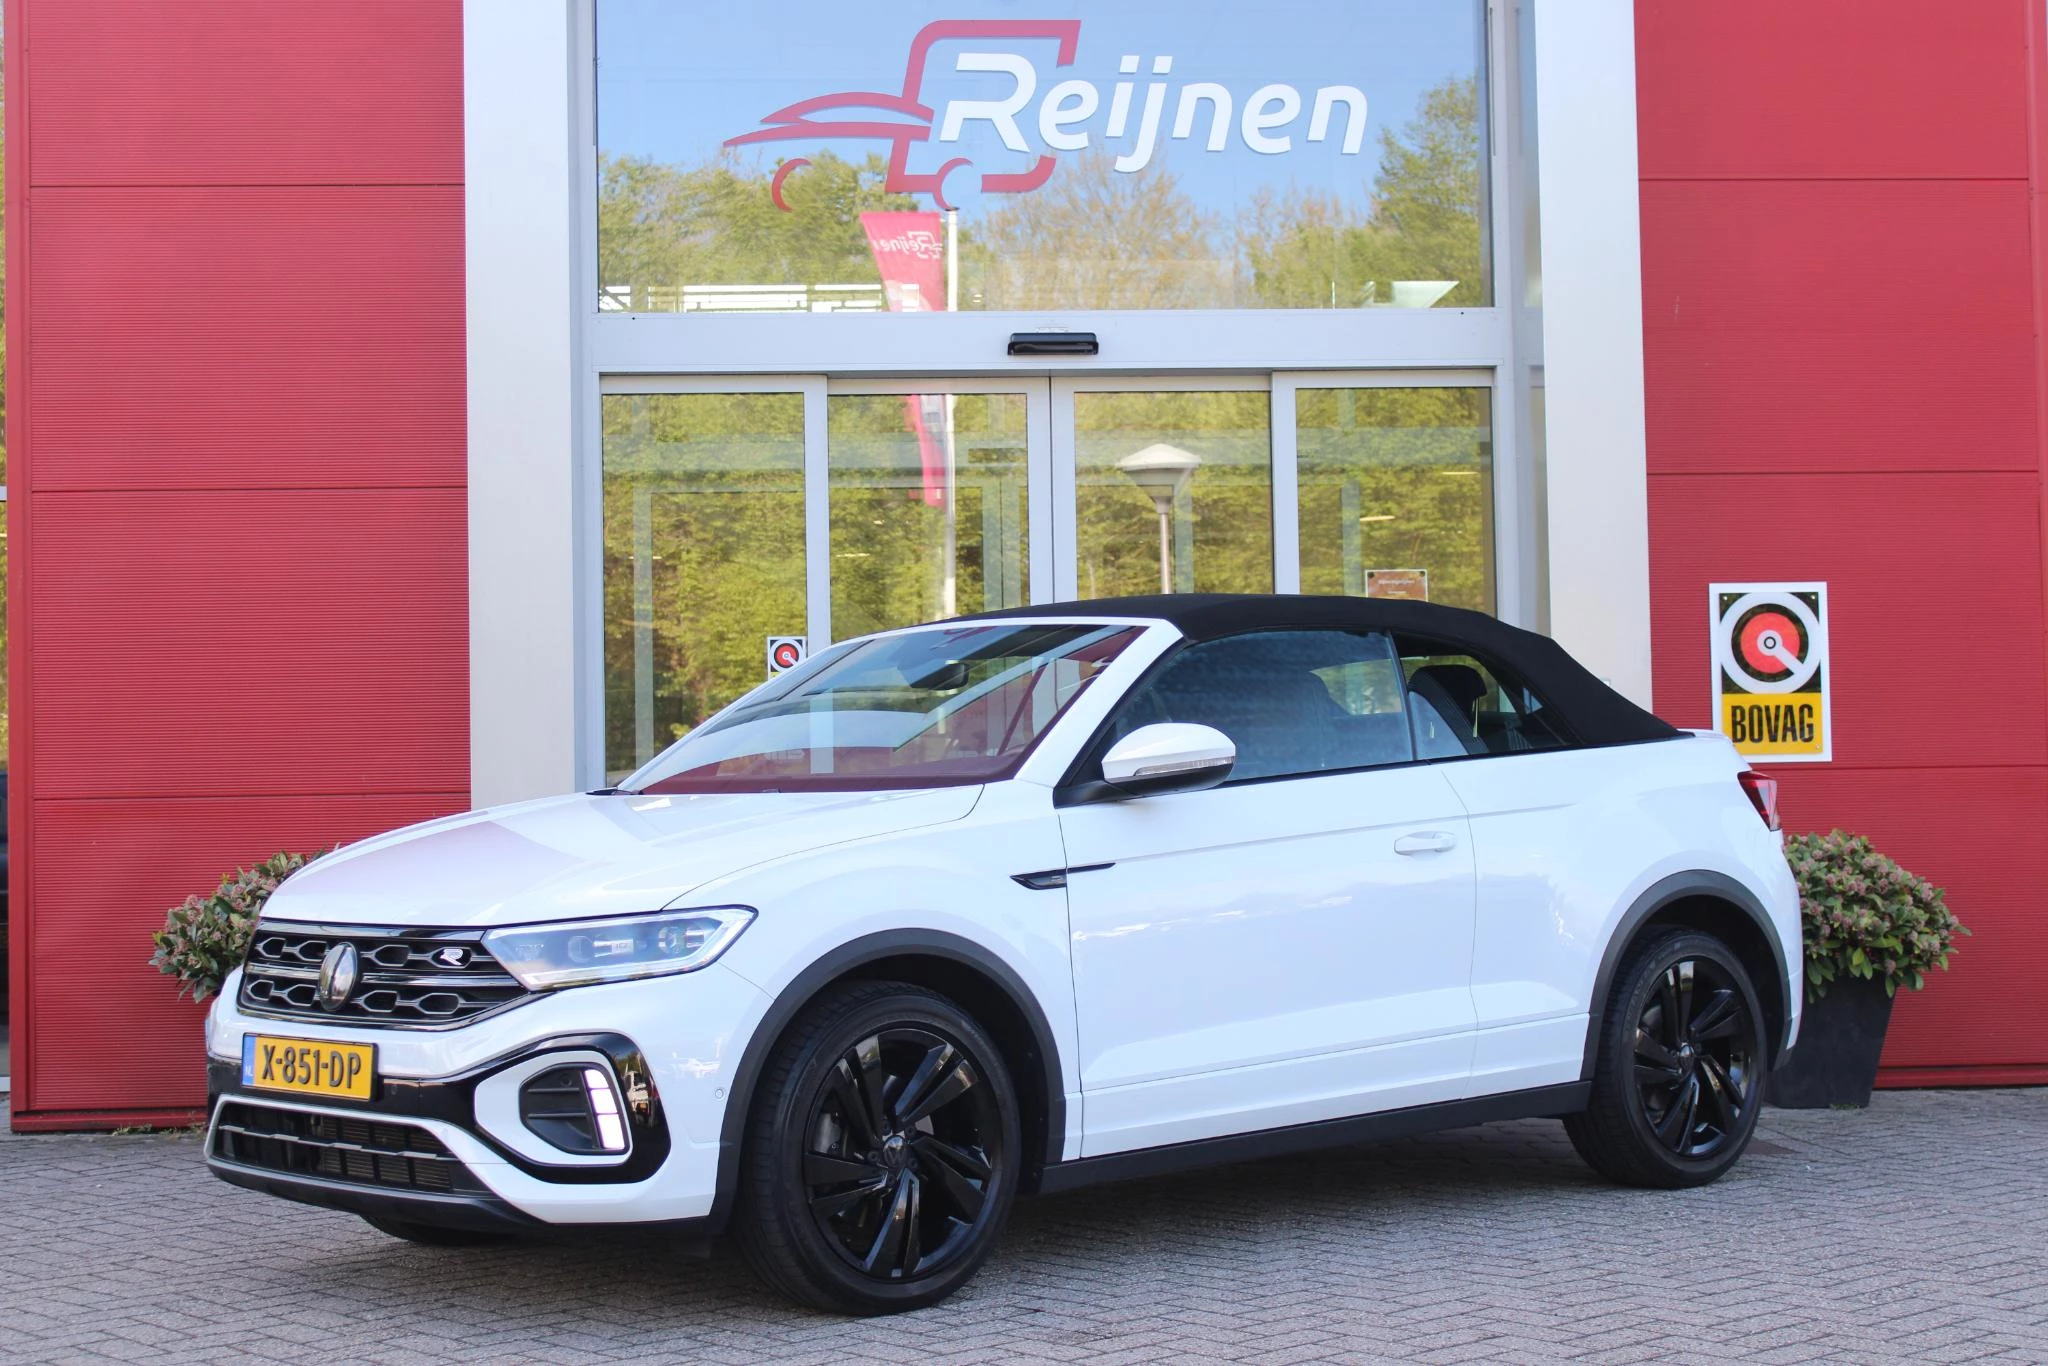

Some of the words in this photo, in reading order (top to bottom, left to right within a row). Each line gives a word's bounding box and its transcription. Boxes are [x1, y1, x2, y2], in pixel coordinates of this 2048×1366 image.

[940, 53, 1368, 172] Reijnen
[1731, 704, 1814, 743] BOVAG
[262, 1044, 361, 1089] X-851-DP
